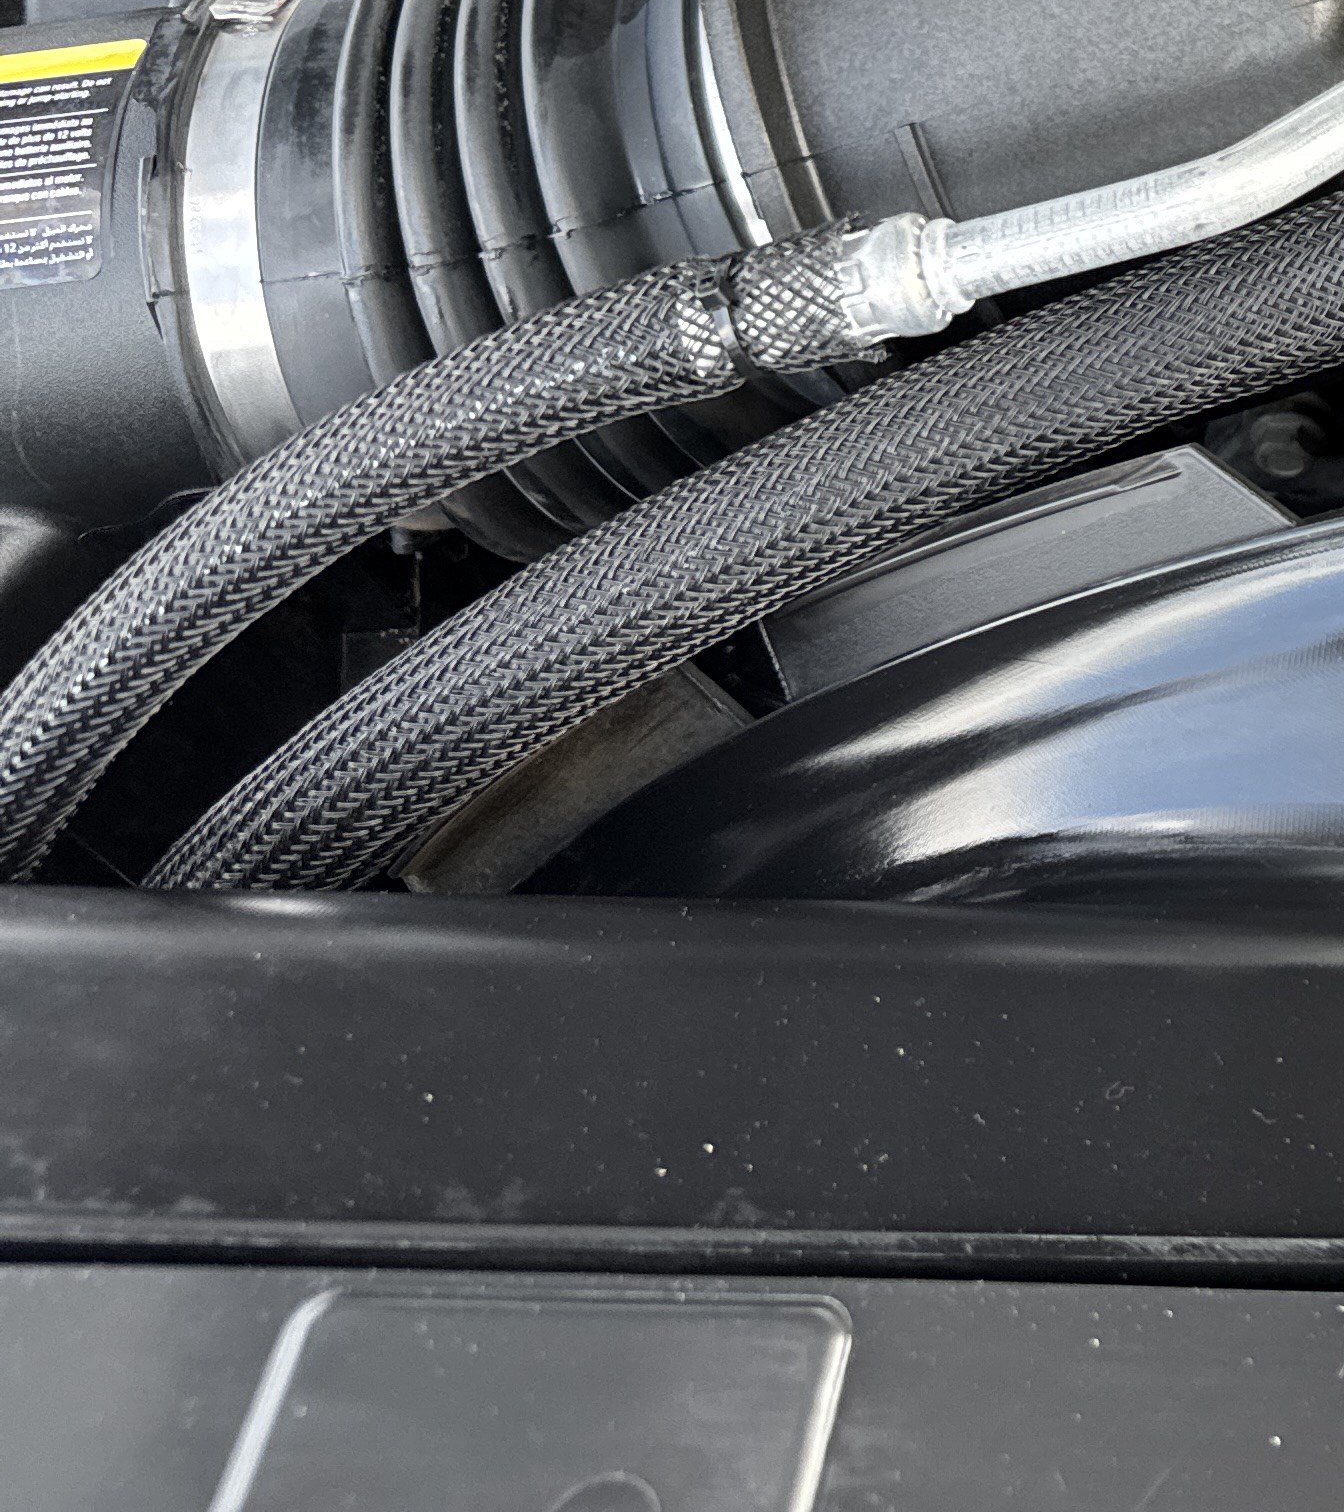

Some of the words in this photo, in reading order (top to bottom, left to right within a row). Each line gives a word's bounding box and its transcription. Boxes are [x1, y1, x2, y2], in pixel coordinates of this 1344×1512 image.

[81, 79, 96, 88] Do
[95, 77, 113, 86] not
[57, 129, 70, 140] 12
[69, 128, 93, 138] volts
[54, 173, 84, 185] motor.
[3, 242, 17, 254] 12
